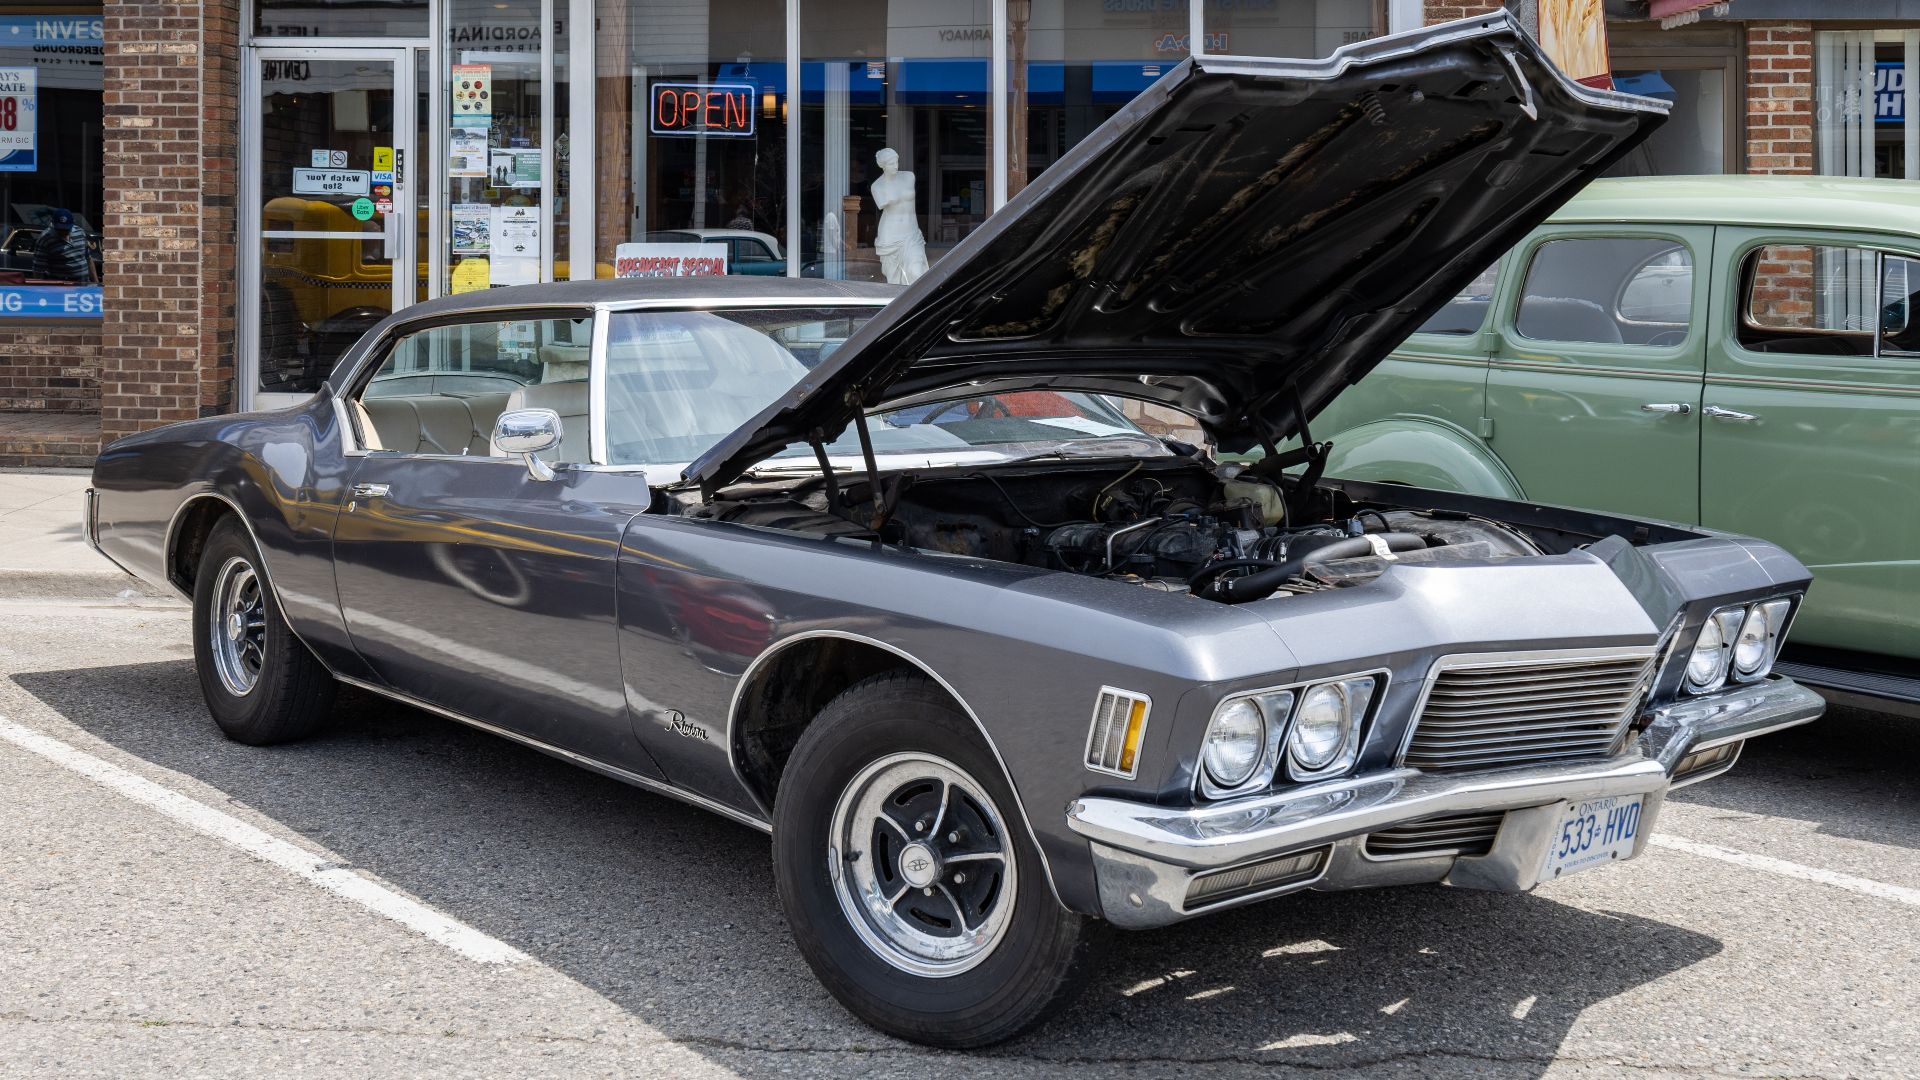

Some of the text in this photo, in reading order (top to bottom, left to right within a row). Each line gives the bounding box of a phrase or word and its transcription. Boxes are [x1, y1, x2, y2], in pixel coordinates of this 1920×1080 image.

[36, 20, 104, 40] INVES
[659, 89, 745, 128] OPEN
[616, 256, 725, 278] BREAKFAST SPECIAL
[1579, 797, 1618, 817] ONTARIO
[1558, 814, 1596, 860] 533
